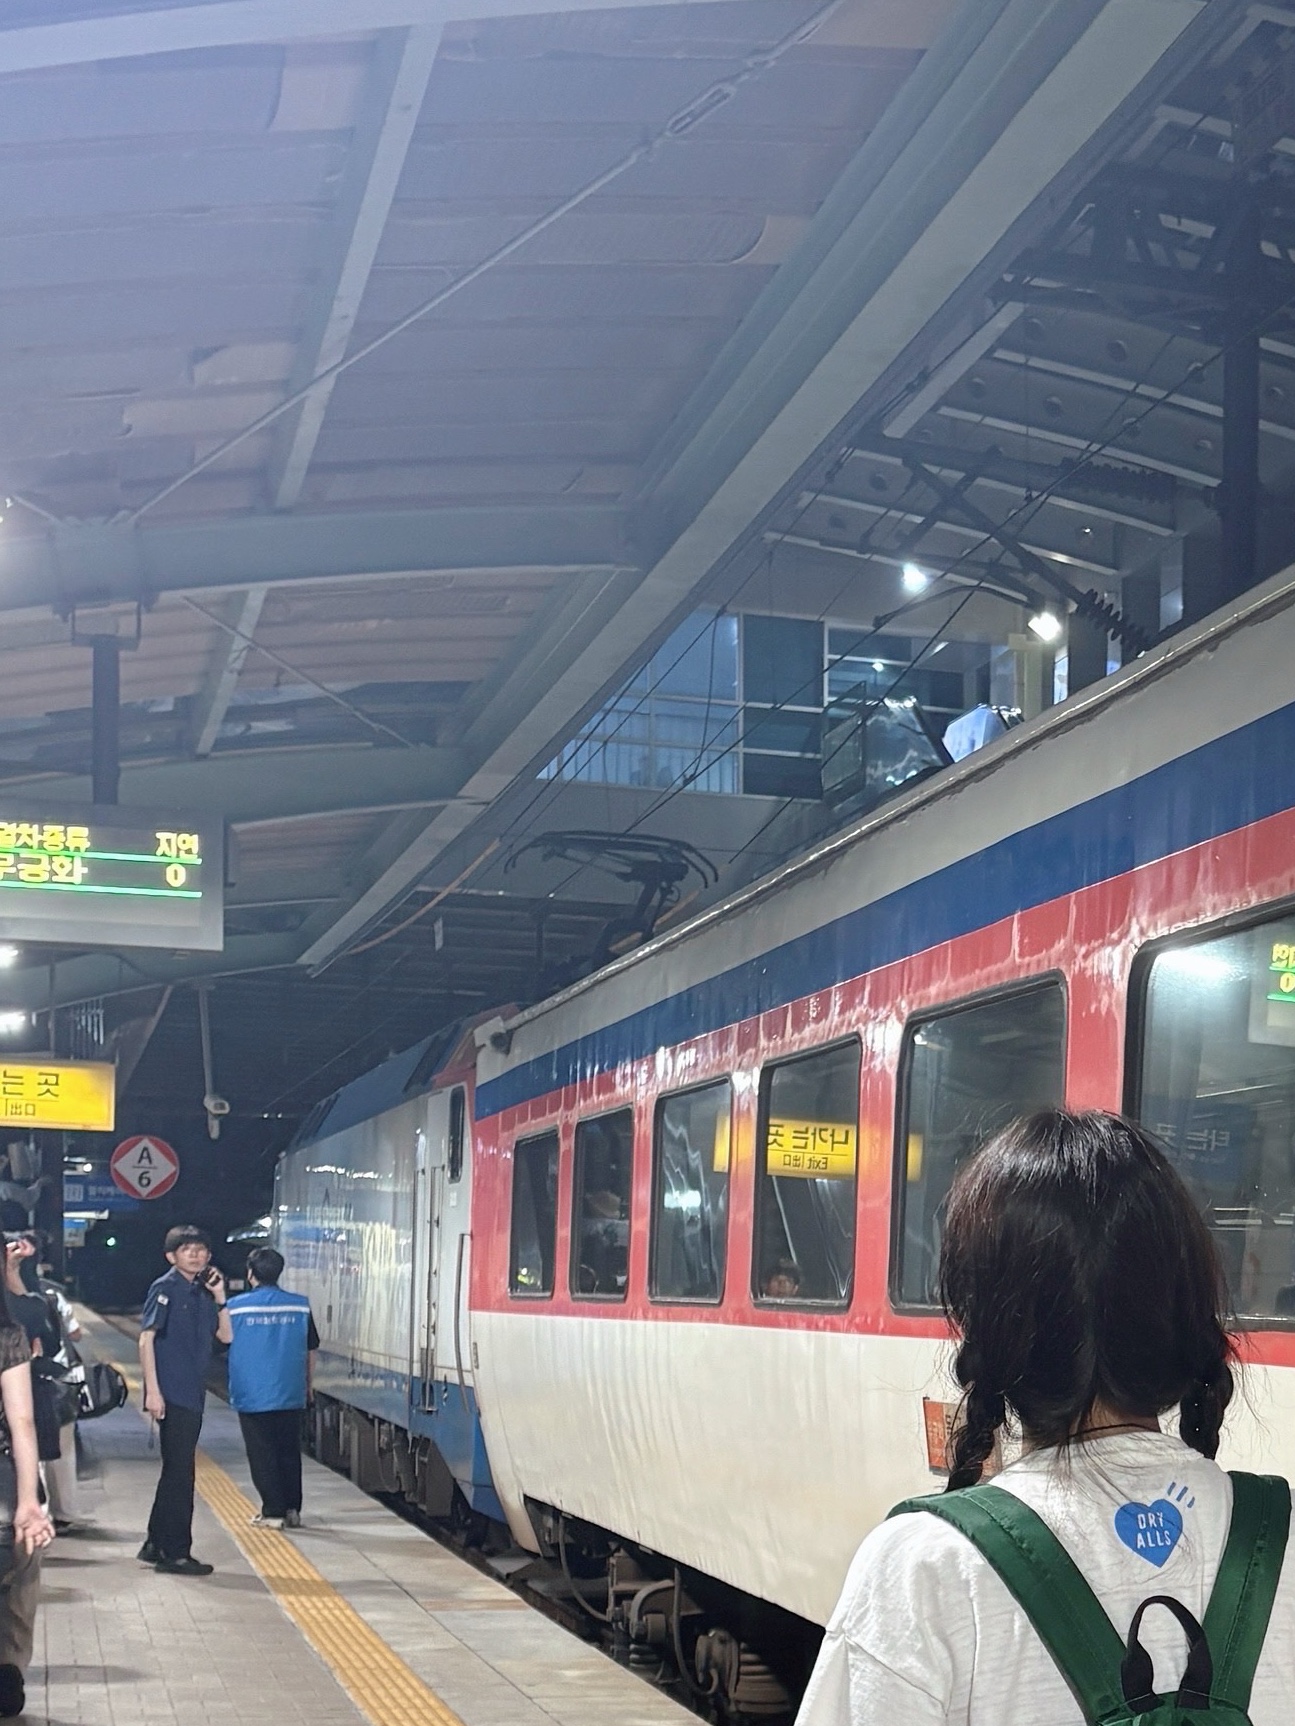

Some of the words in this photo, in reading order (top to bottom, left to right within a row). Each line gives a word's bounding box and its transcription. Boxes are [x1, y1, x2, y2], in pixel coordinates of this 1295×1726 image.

[155, 831, 199, 860] 지연
[165, 864, 186, 887] 0
[37, 1072, 60, 1098] 곳
[10, 1103, 36, 1117] 出口
[138, 1146, 153, 1165] A
[138, 1170, 152, 1189] 6
[1137, 1512, 1164, 1530] DRY
[1136, 1530, 1171, 1549] ALLS
